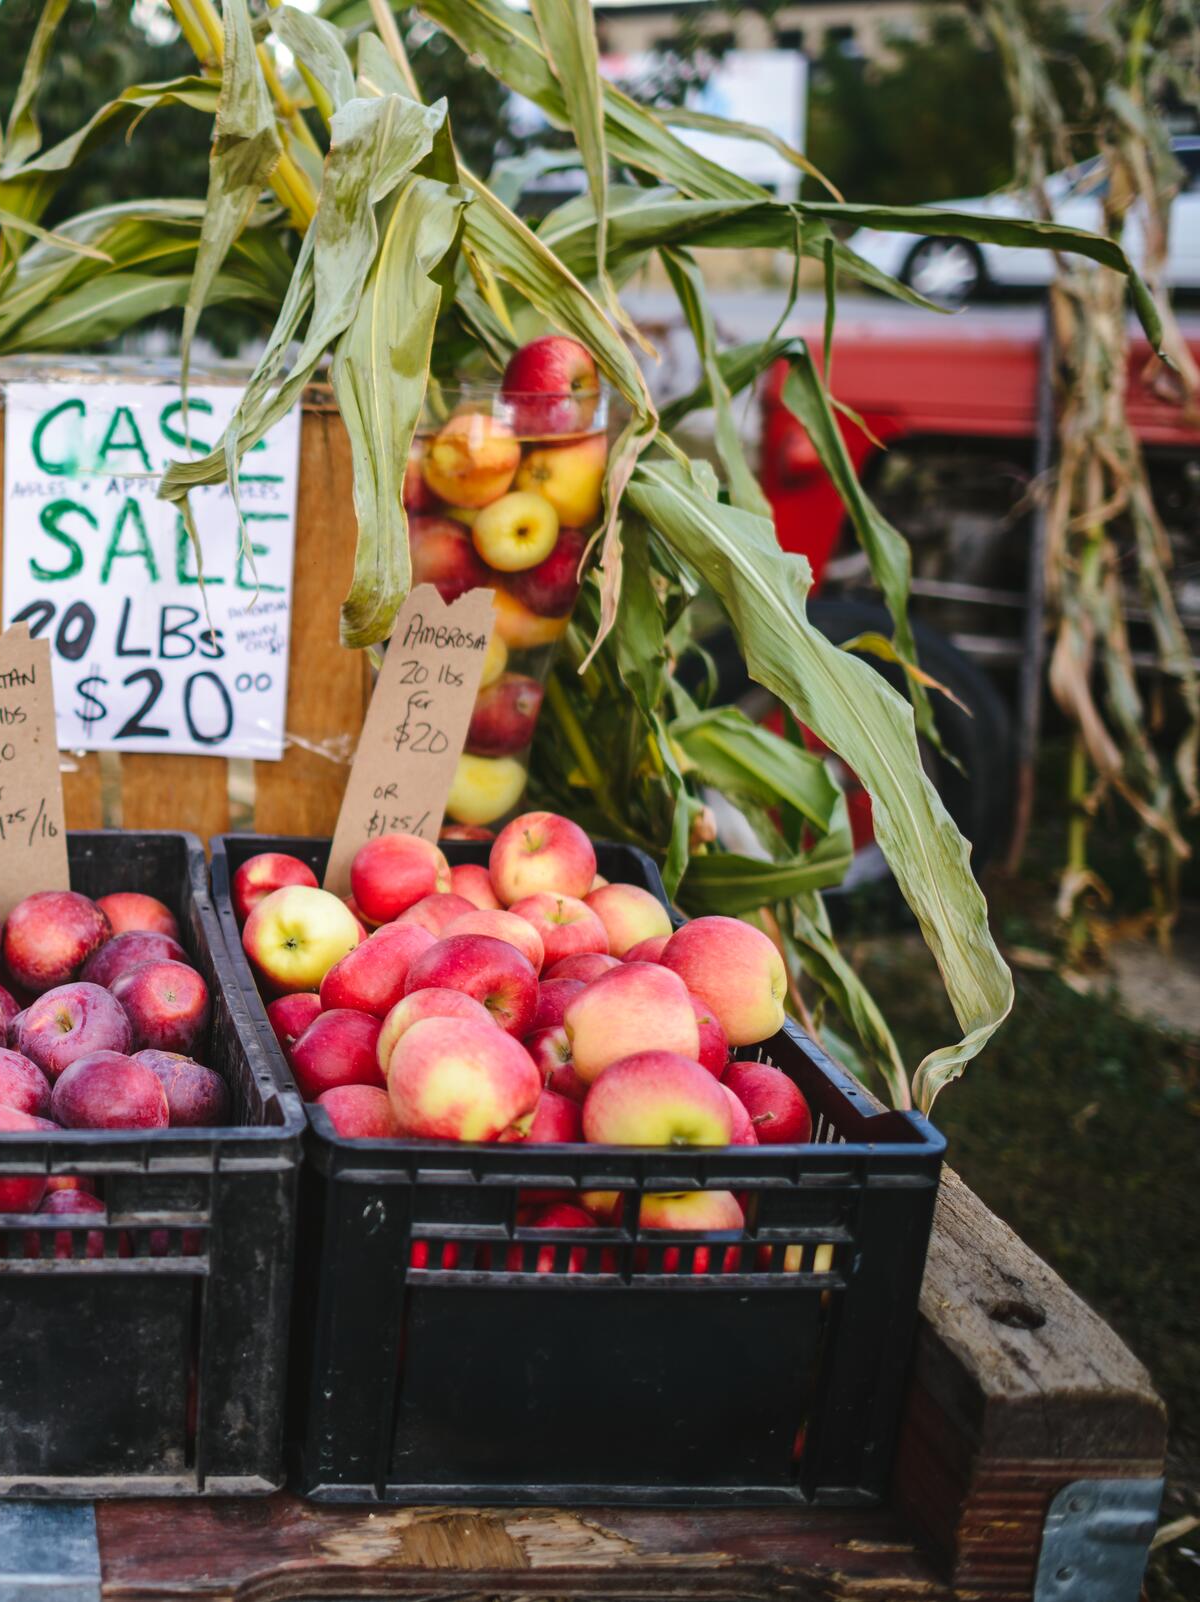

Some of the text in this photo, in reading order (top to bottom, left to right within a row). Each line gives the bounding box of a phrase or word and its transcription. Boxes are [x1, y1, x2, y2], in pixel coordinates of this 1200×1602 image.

[29, 497, 289, 592] SALE
[114, 597, 225, 660] LBs
[399, 660, 463, 687] 20 lbs
[0, 705, 28, 725] lbs
[394, 720, 449, 753] $20
